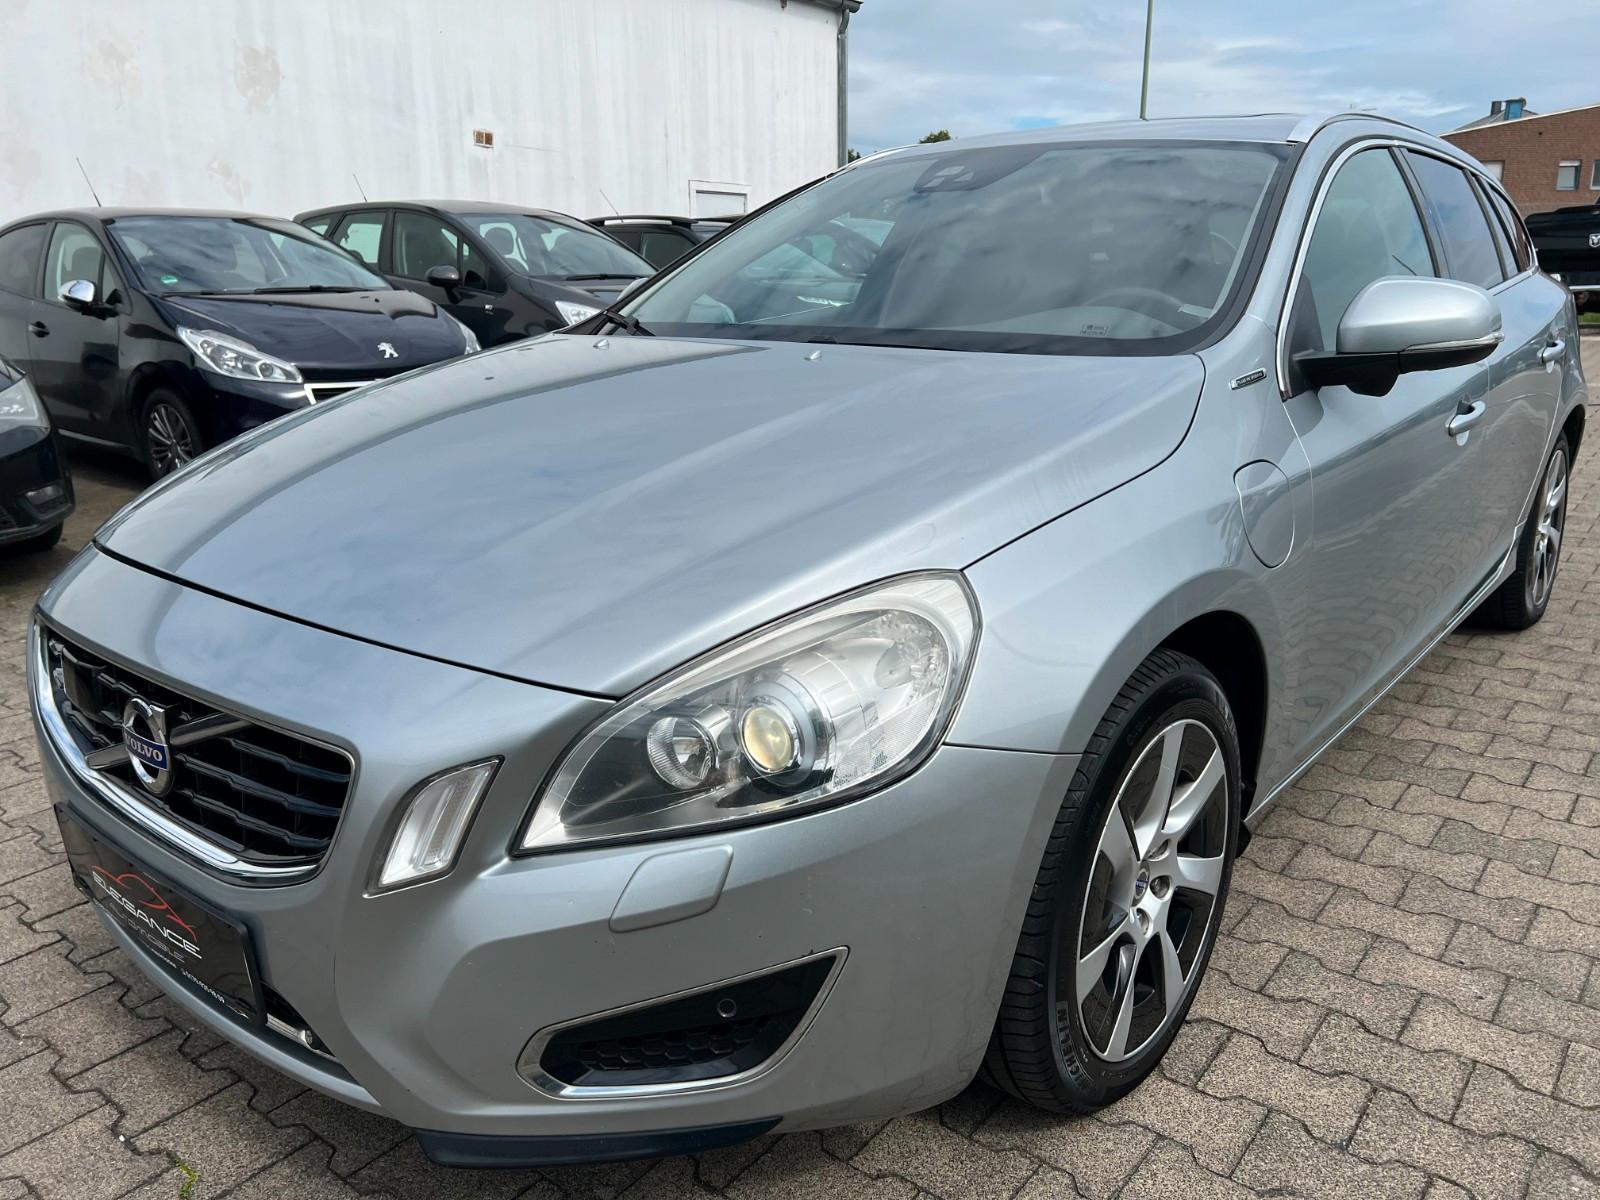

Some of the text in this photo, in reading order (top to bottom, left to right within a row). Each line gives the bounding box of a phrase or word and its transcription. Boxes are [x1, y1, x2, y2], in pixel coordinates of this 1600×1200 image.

[125, 732, 163, 761] VOLVO
[92, 870, 203, 960] ELEGANCE
[1057, 1008, 1089, 1089] ICHELIN
